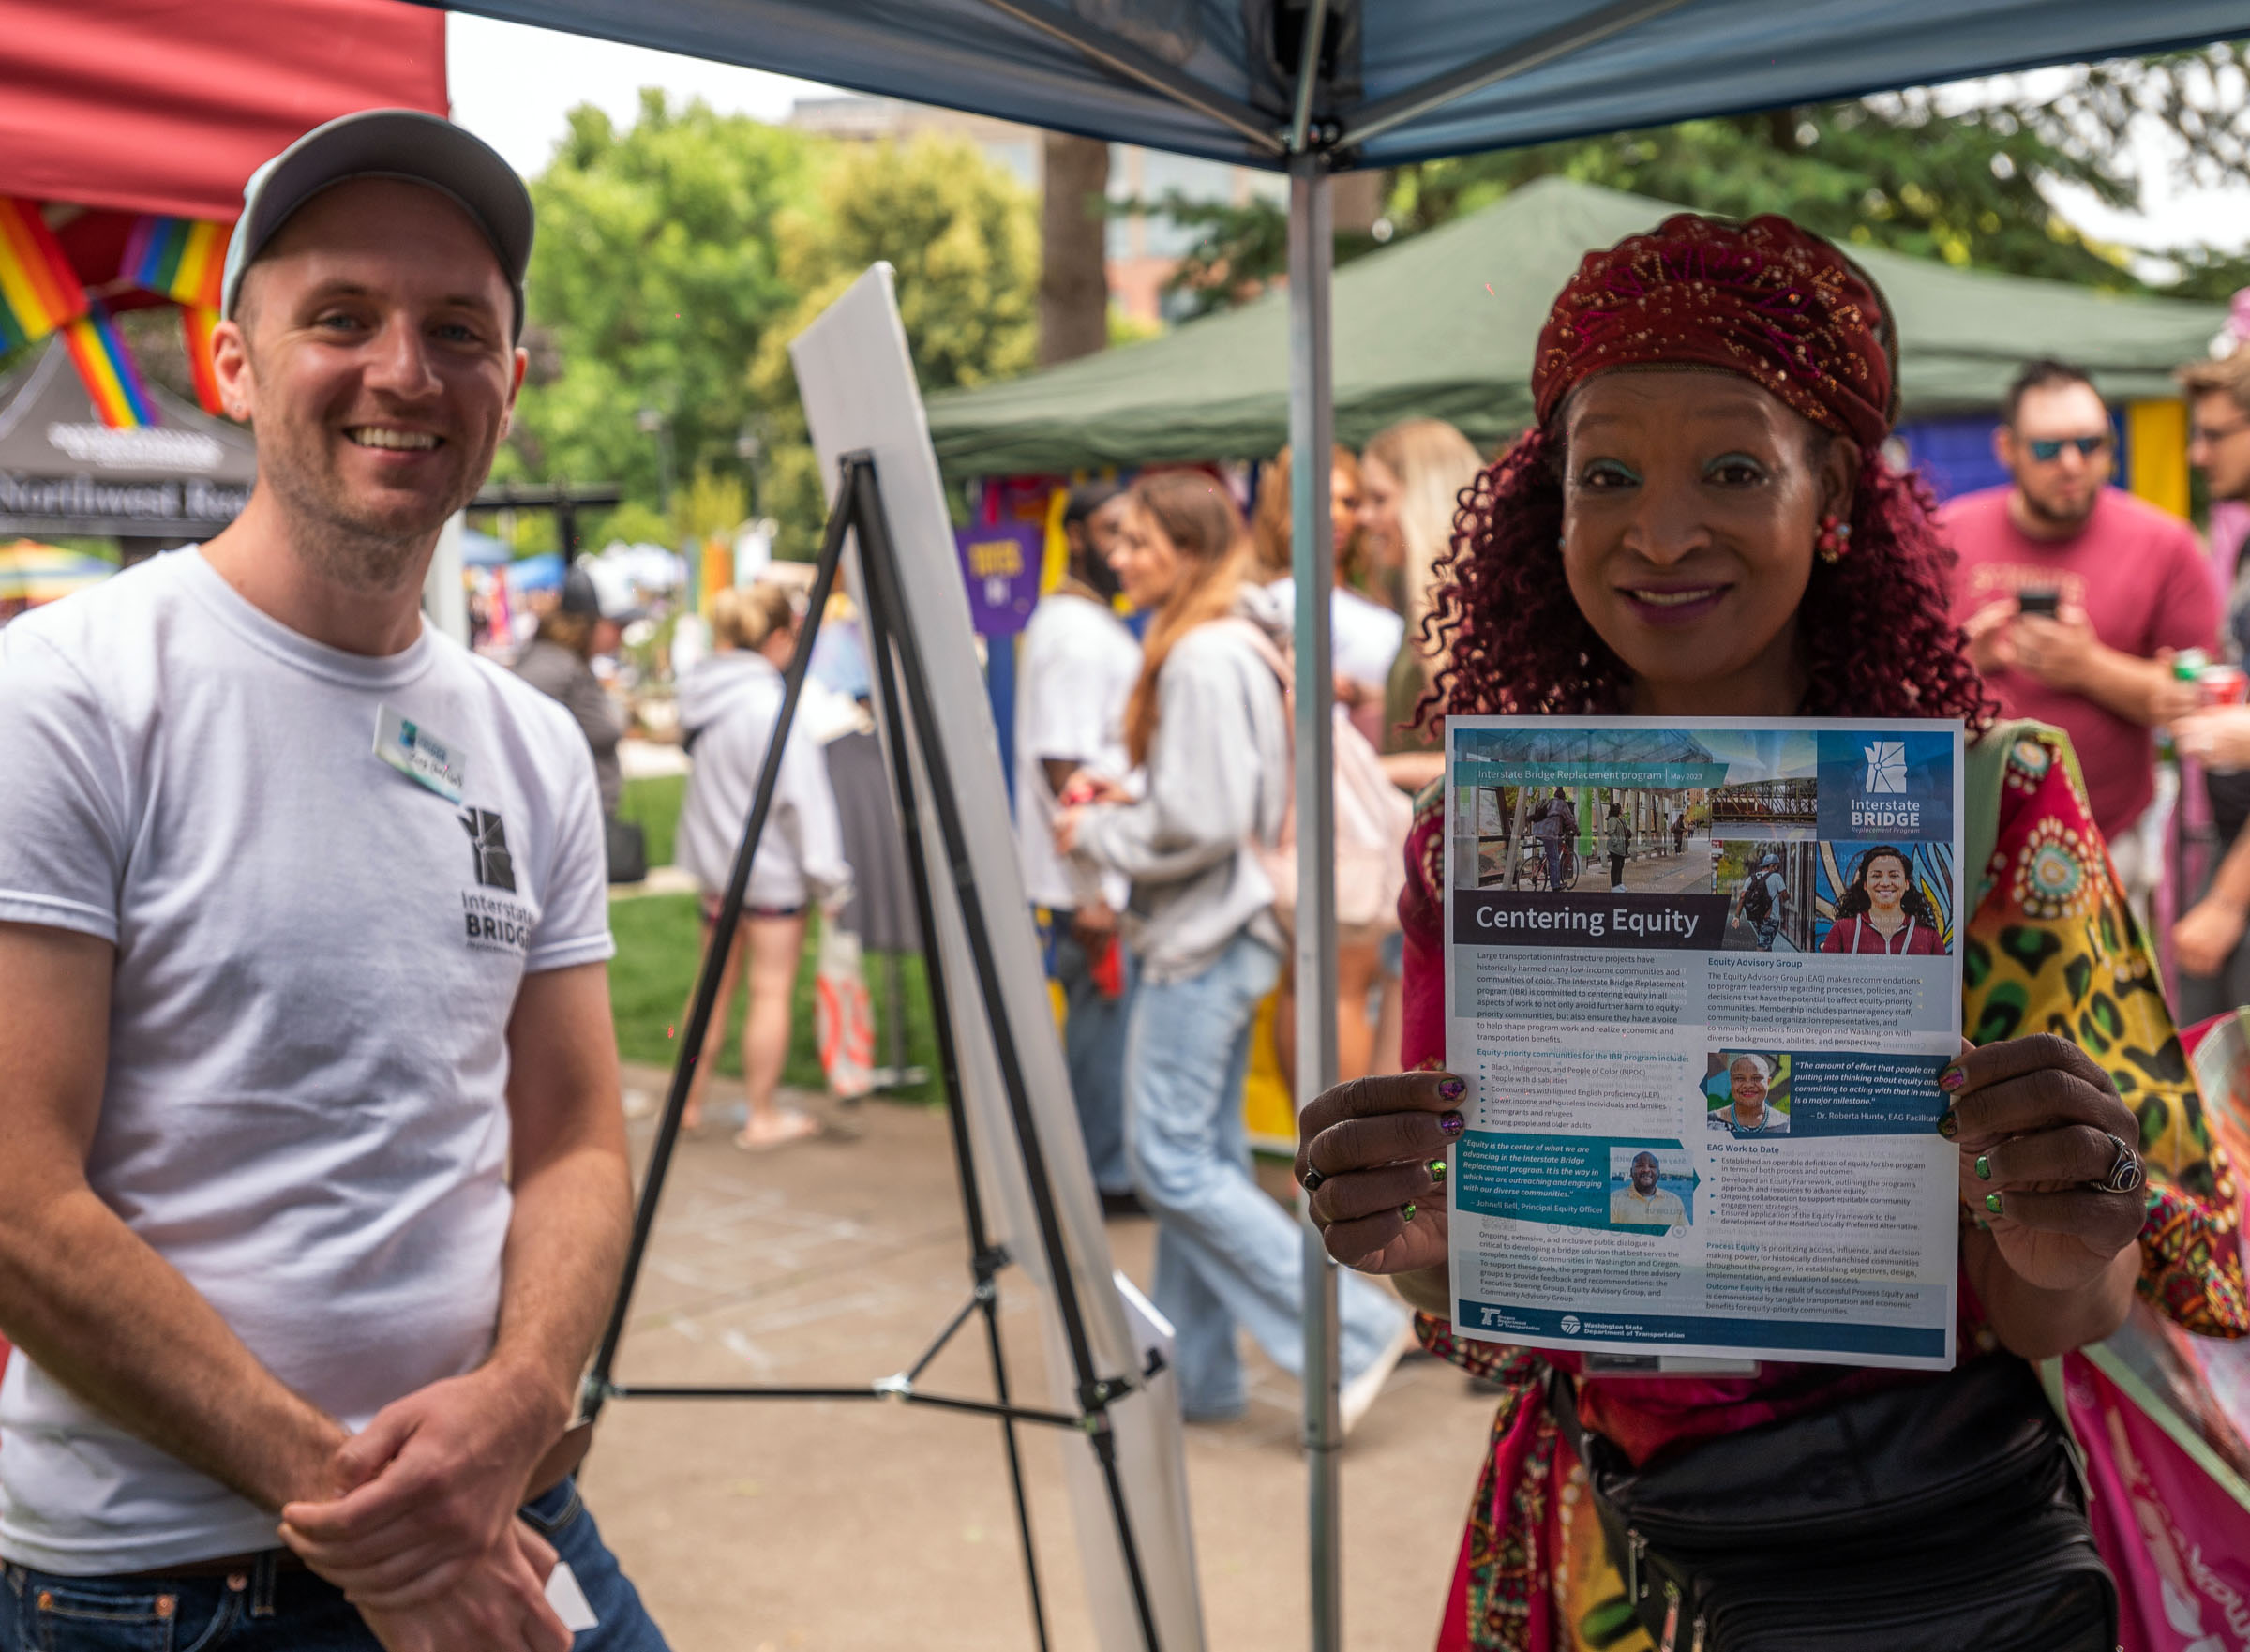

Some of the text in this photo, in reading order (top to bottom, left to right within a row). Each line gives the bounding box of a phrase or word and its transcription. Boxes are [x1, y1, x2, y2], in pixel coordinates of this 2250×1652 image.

[1525, 771, 1555, 781] Bridge
[1558, 772, 1619, 782] Replacement
[1622, 773, 1661, 782] program
[1672, 773, 1685, 782] May
[1852, 799, 1920, 811] Interstate
[1852, 812, 1919, 826] BRIDGE
[461, 890, 536, 924] Interstate
[1477, 906, 1699, 938] Centering Equity
[1478, 953, 1497, 962] Large
[1499, 954, 1552, 963] transportation
[1605, 955, 1635, 965] projects
[1709, 958, 1802, 969] Equity Advisory Group
[1478, 964, 1516, 974] historically
[1616, 967, 1663, 975] communities
[1478, 975, 1524, 984] communities
[1610, 979, 1633, 988] Bridge
[1635, 979, 1684, 990] Replacement
[1723, 973, 1746, 983] Equity
[1748, 973, 1778, 984] Advisory
[1781, 974, 1803, 984] Group
[1806, 975, 1824, 984] (EAG)
[1853, 976, 1920, 984] recommendations
[1749, 984, 1787, 994] leadership
[1790, 984, 1825, 995] regarding
[1867, 986, 1897, 997] policies,
[1792, 996, 1825, 1005] potential
[1859, 997, 1912, 1008] equity-priority
[1708, 1003, 1755, 1012] communities.
[1760, 1005, 1804, 1015] Membership
[1838, 1008, 1865, 1017] partner
[1895, 1009, 1912, 1017] staff,
[1478, 1047, 1531, 1059] Equity-priority
[1533, 1049, 1581, 1059] communities
[1596, 1051, 1607, 1059] the
[1625, 1054, 1657, 1062] program
[1658, 1054, 1688, 1062] include:
[1846, 1064, 1854, 1073] of
[1855, 1064, 1876, 1074] effort
[1896, 1065, 1921, 1075] people
[1795, 1074, 1822, 1084] putting
[1841, 1075, 1871, 1085] thinking
[1898, 1077, 1922, 1087] equity
[1795, 1085, 1838, 1095] committing
[1850, 1087, 1872, 1097] acting
[1809, 1097, 1831, 1106] major
[1545, 1110, 1572, 1119] refugees
[1536, 1144, 1543, 1152] of
[1707, 1144, 1723, 1152] EAG
[1463, 1151, 1499, 1161] advancing
[1561, 1156, 1584, 1165] Bridge
[1463, 1162, 1508, 1173] Replacement
[1510, 1166, 1544, 1175] program.
[1509, 1176, 1551, 1186] outreaching
[1568, 1179, 1602, 1189] engaging
[1504, 1201, 1519, 1209] Bell,
[1522, 1203, 1552, 1212] Principal
[1554, 1204, 1578, 1214] Equity
[1580, 1206, 1603, 1215] Officer
[1584, 1322, 1623, 1331] Washington
[1635, 1330, 1685, 1339] Transportation
